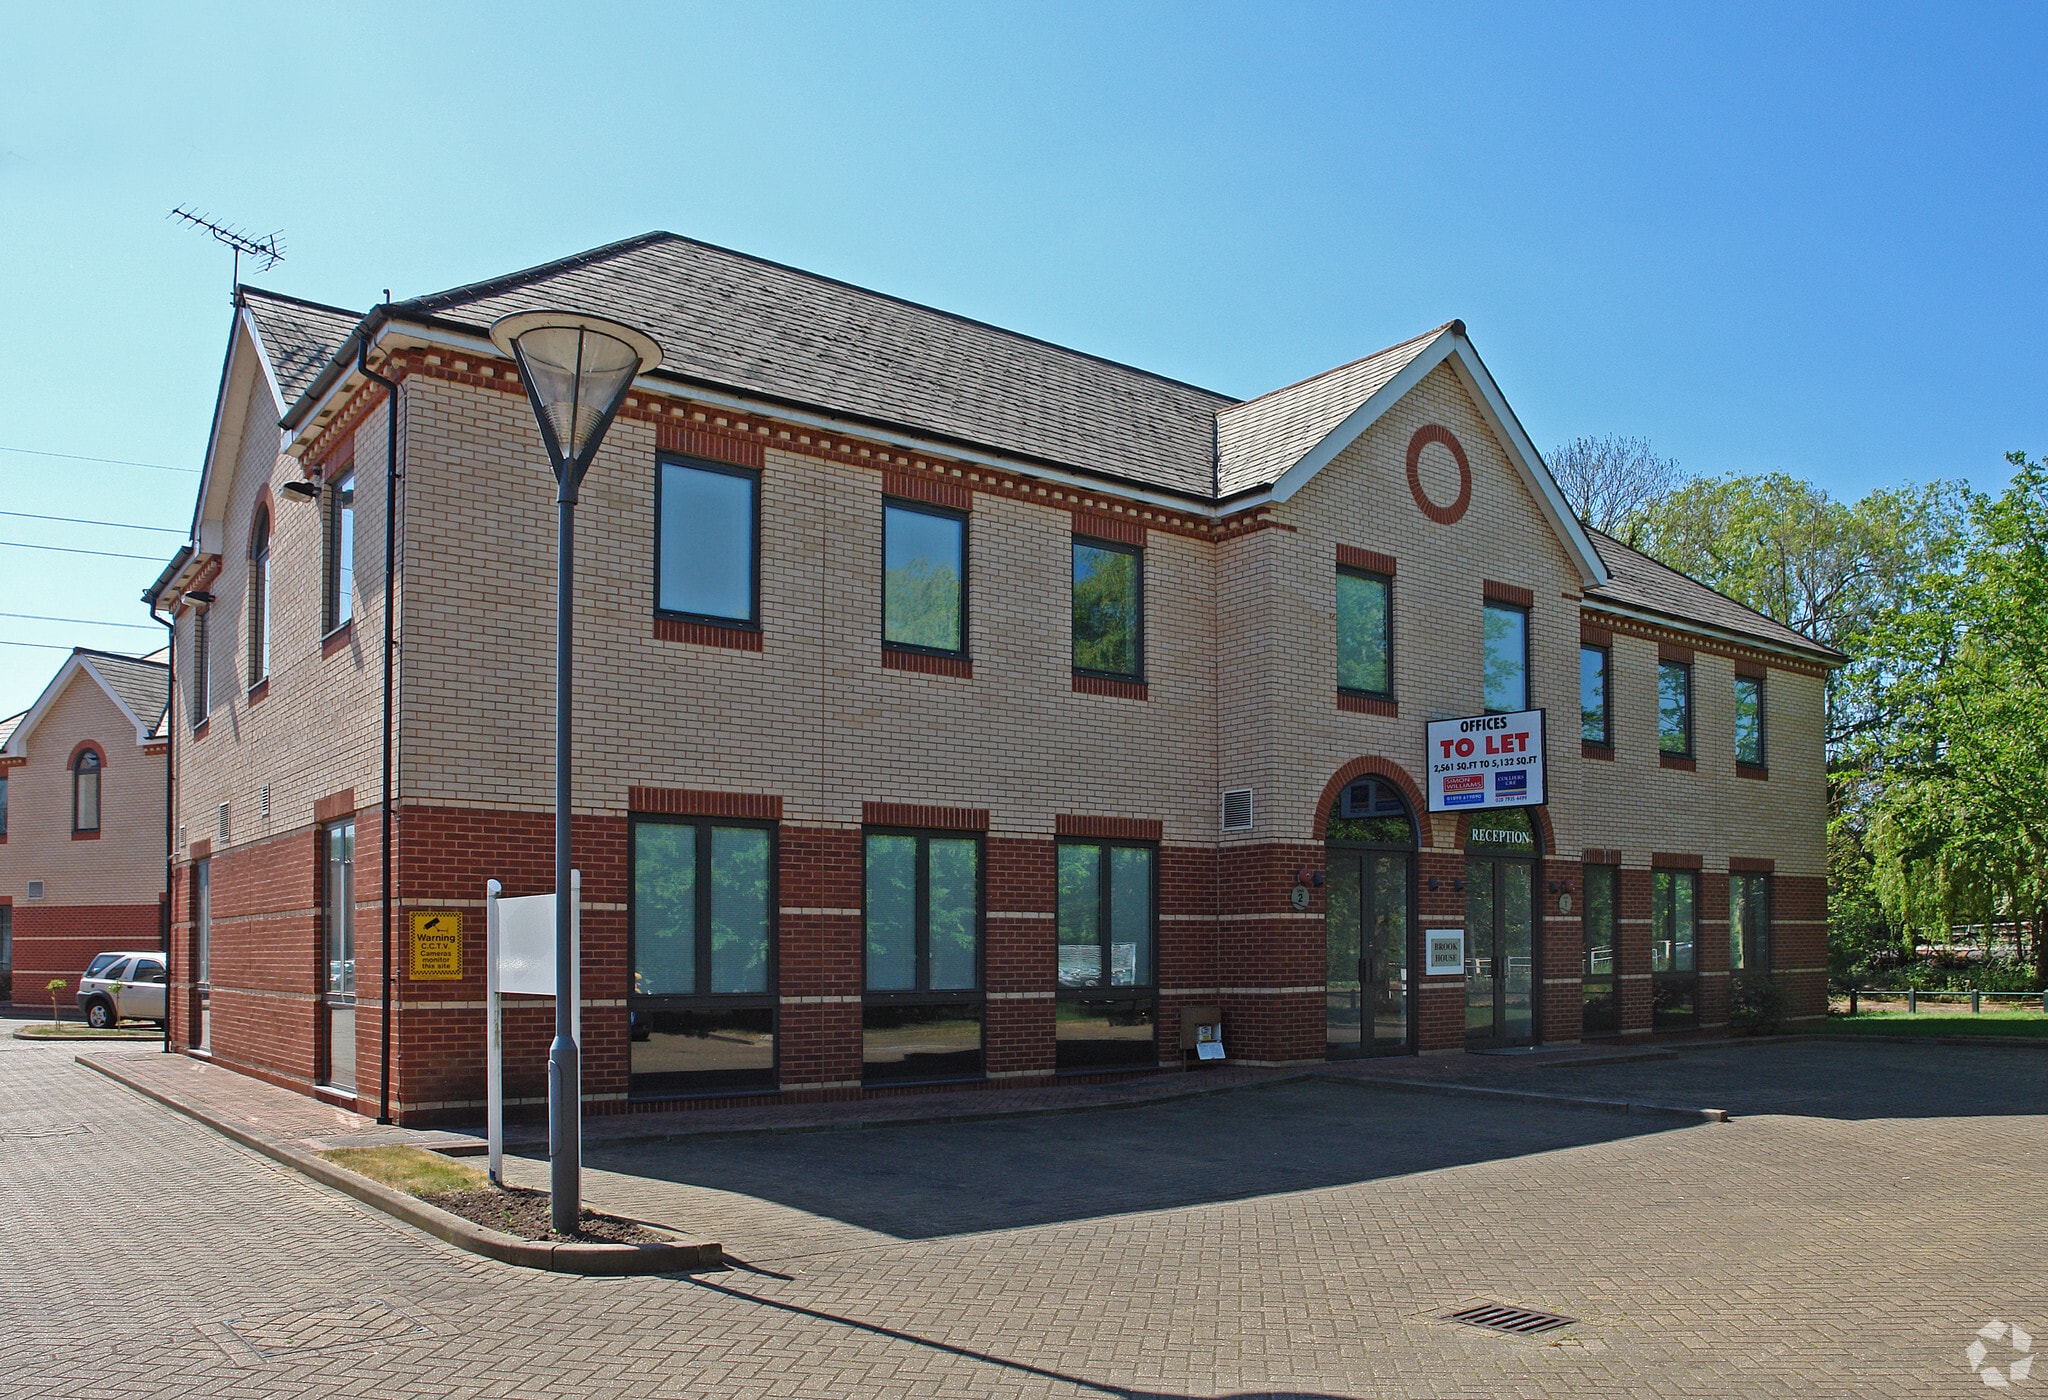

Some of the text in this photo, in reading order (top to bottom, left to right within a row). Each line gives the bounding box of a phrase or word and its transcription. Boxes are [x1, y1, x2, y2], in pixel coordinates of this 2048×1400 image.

[1460, 716, 1507, 733] OFFICES
[1440, 731, 1530, 759] TO LET
[1434, 755, 1537, 773] 2,561 SQ.FT TO 5,132 SQ.FT
[1472, 828, 1530, 844] RECEPTION
[1298, 893, 1304, 902] 2
[417, 934, 456, 943] Warning
[1434, 942, 1458, 951] BROOK
[1435, 954, 1457, 962] HOUSE
